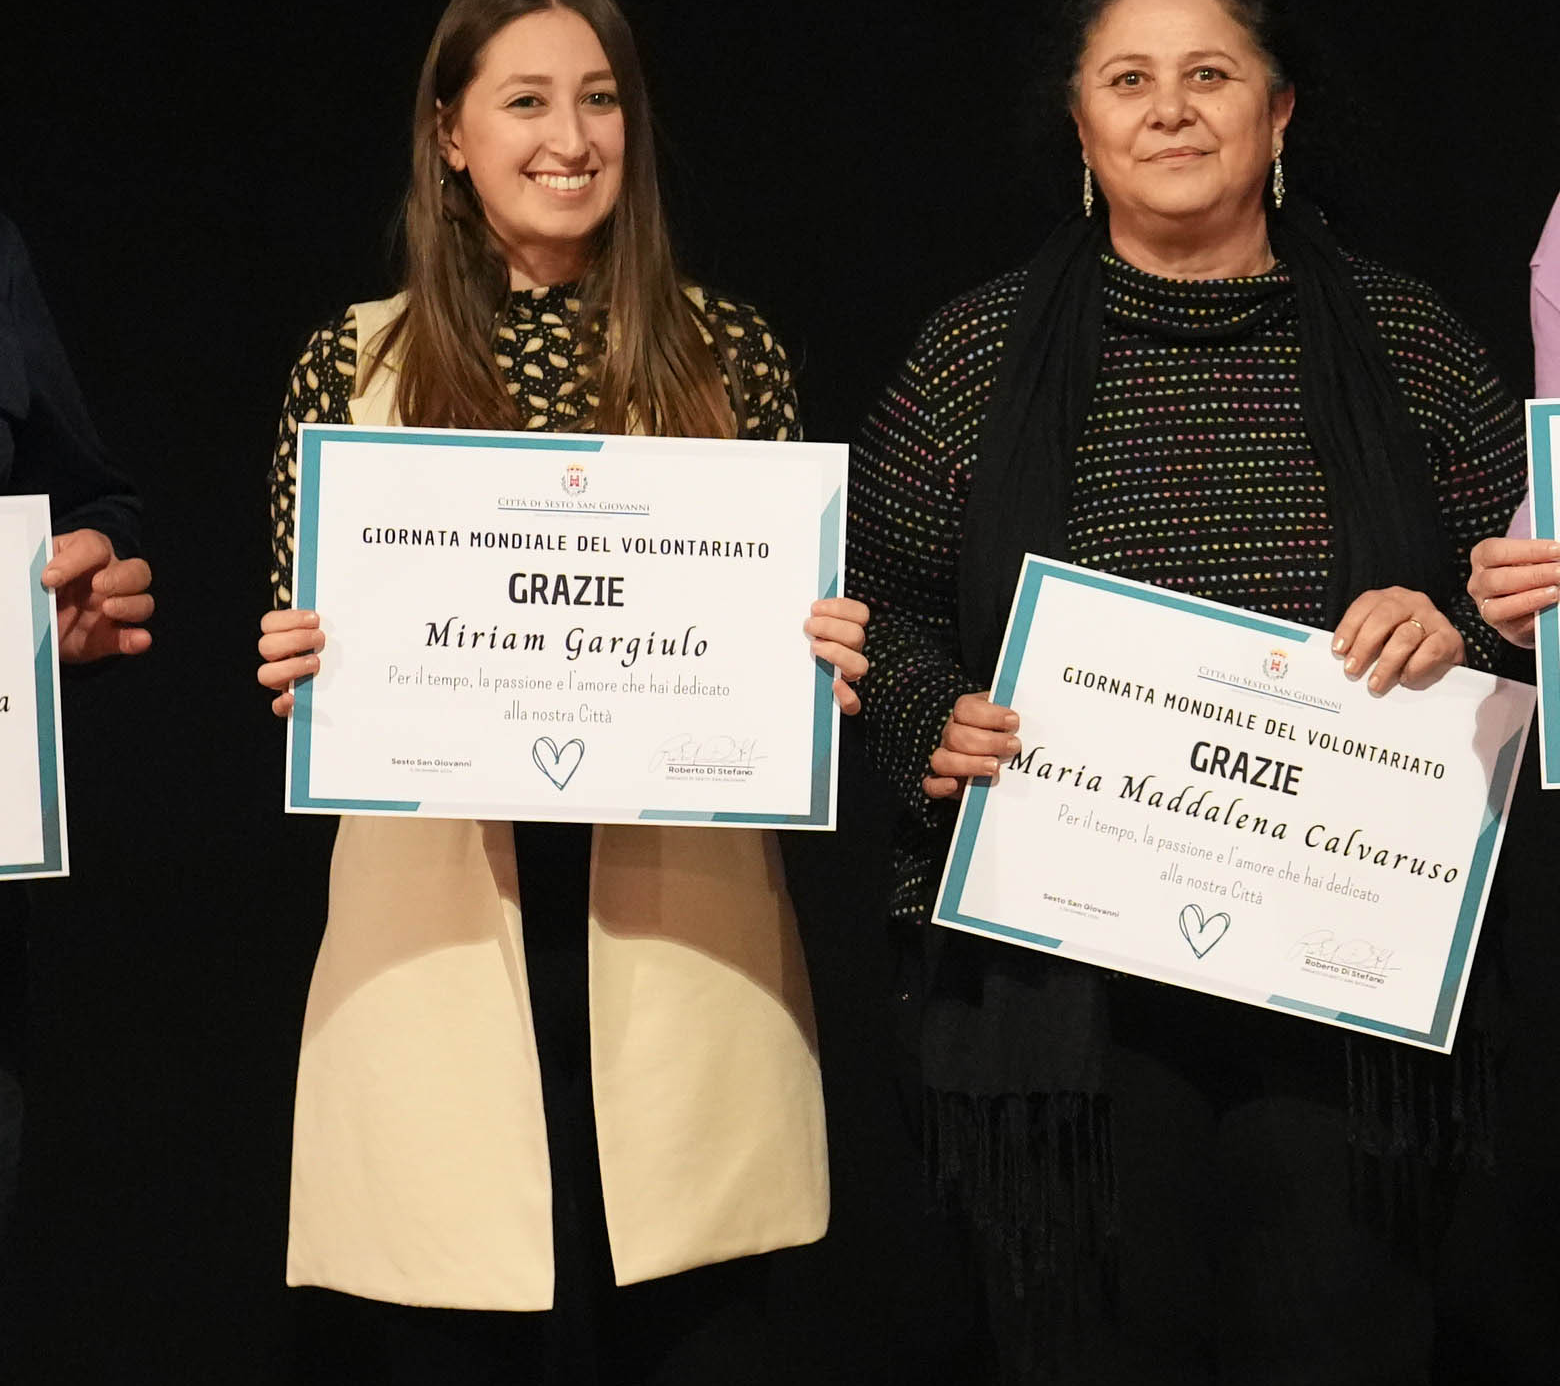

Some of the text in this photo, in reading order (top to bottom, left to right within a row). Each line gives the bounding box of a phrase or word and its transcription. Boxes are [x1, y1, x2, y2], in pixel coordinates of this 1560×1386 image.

[362, 527, 769, 559] GIORNATA MONDIALE DEL VOLONTARIATO
[508, 572, 625, 608] GRAZIE
[425, 616, 708, 668] Miriam Gargiulo
[388, 664, 730, 697] Per il tempo, la passione e l'amore che hai dedicato
[503, 699, 612, 724] alla nostra Città
[1062, 666, 1445, 780] GIORNATA MONDIALE DEL VOLONTARIATO
[1190, 741, 1304, 796] GRAZIE
[1008, 746, 1459, 884] Maria Maddalena Calvaruso
[1057, 803, 1380, 904] Per il tempo, la passione e l'amore che hai dedicato
[1159, 861, 1263, 905] alla nostra Città
